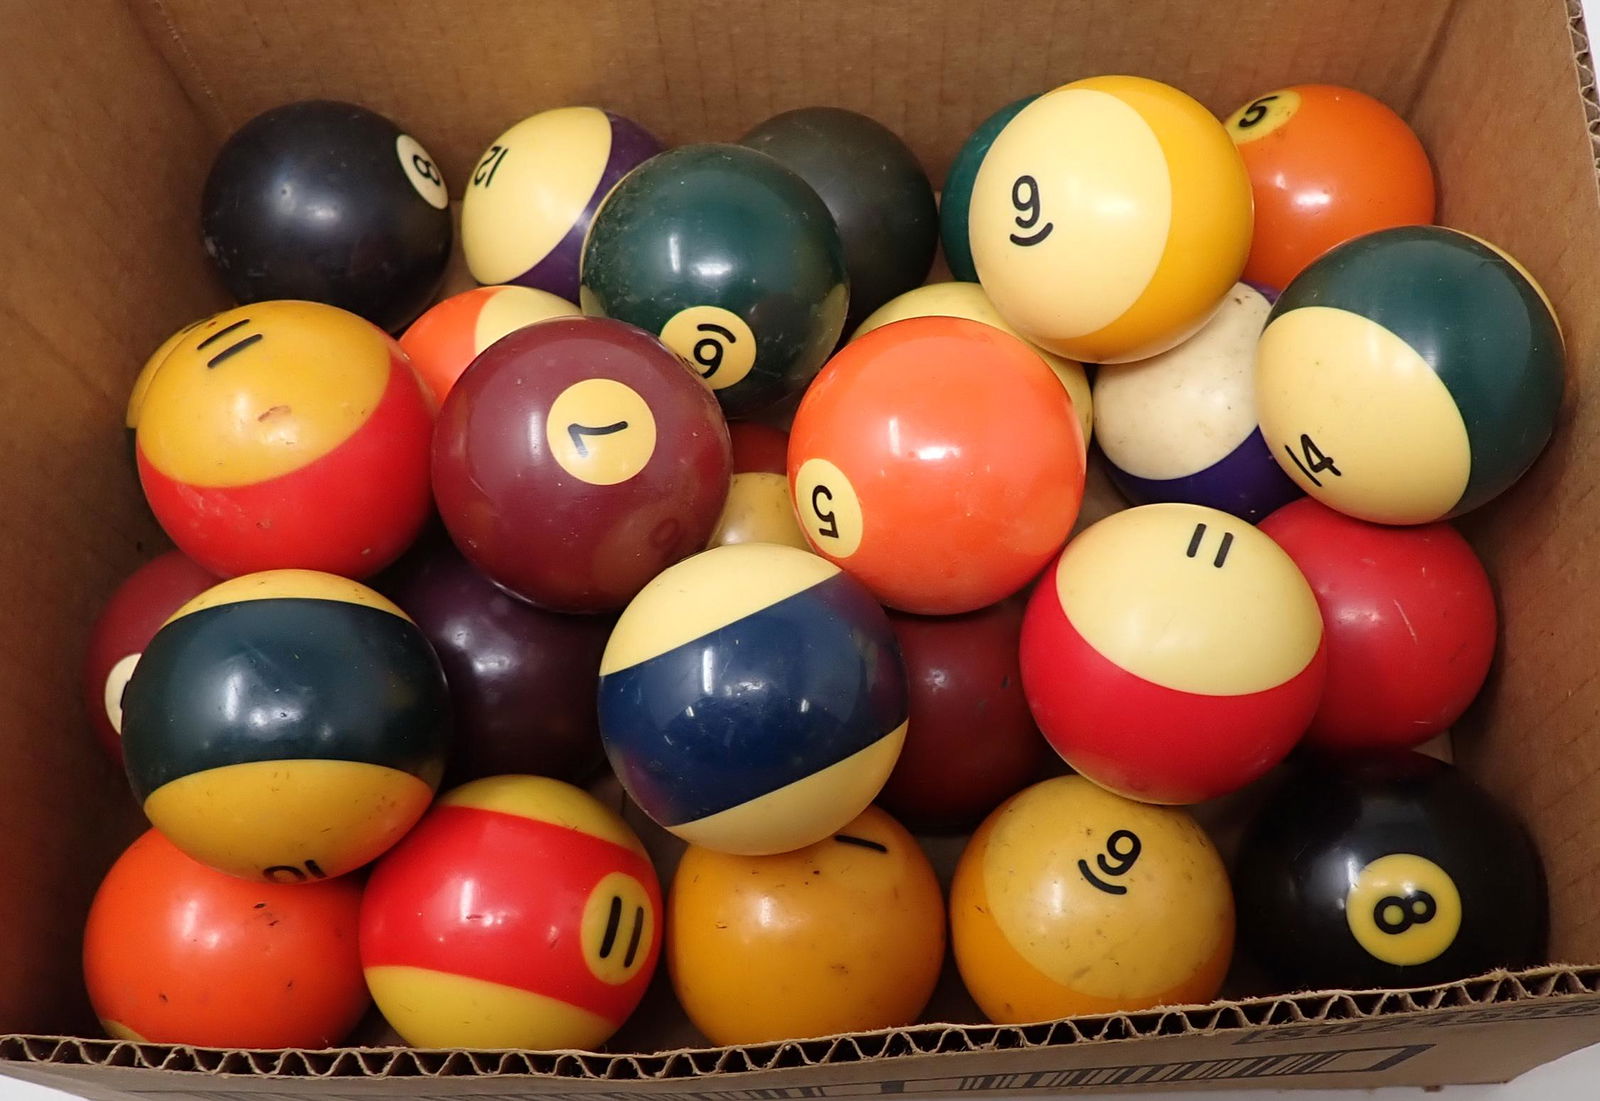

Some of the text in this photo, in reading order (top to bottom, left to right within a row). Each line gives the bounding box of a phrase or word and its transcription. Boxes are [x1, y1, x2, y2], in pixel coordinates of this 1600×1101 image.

[1238, 95, 1279, 128] 5
[413, 153, 439, 187] 8
[474, 146, 510, 188] 12
[1011, 174, 1042, 230] 9
[196, 318, 264, 369] 11
[693, 337, 725, 380] 6
[568, 421, 628, 456] 7
[1284, 433, 1342, 487] 14
[811, 484, 840, 540] 5
[1186, 522, 1234, 569] 11
[1096, 829, 1142, 877] 9
[598, 895, 645, 970] 11
[1372, 889, 1438, 936] 8
